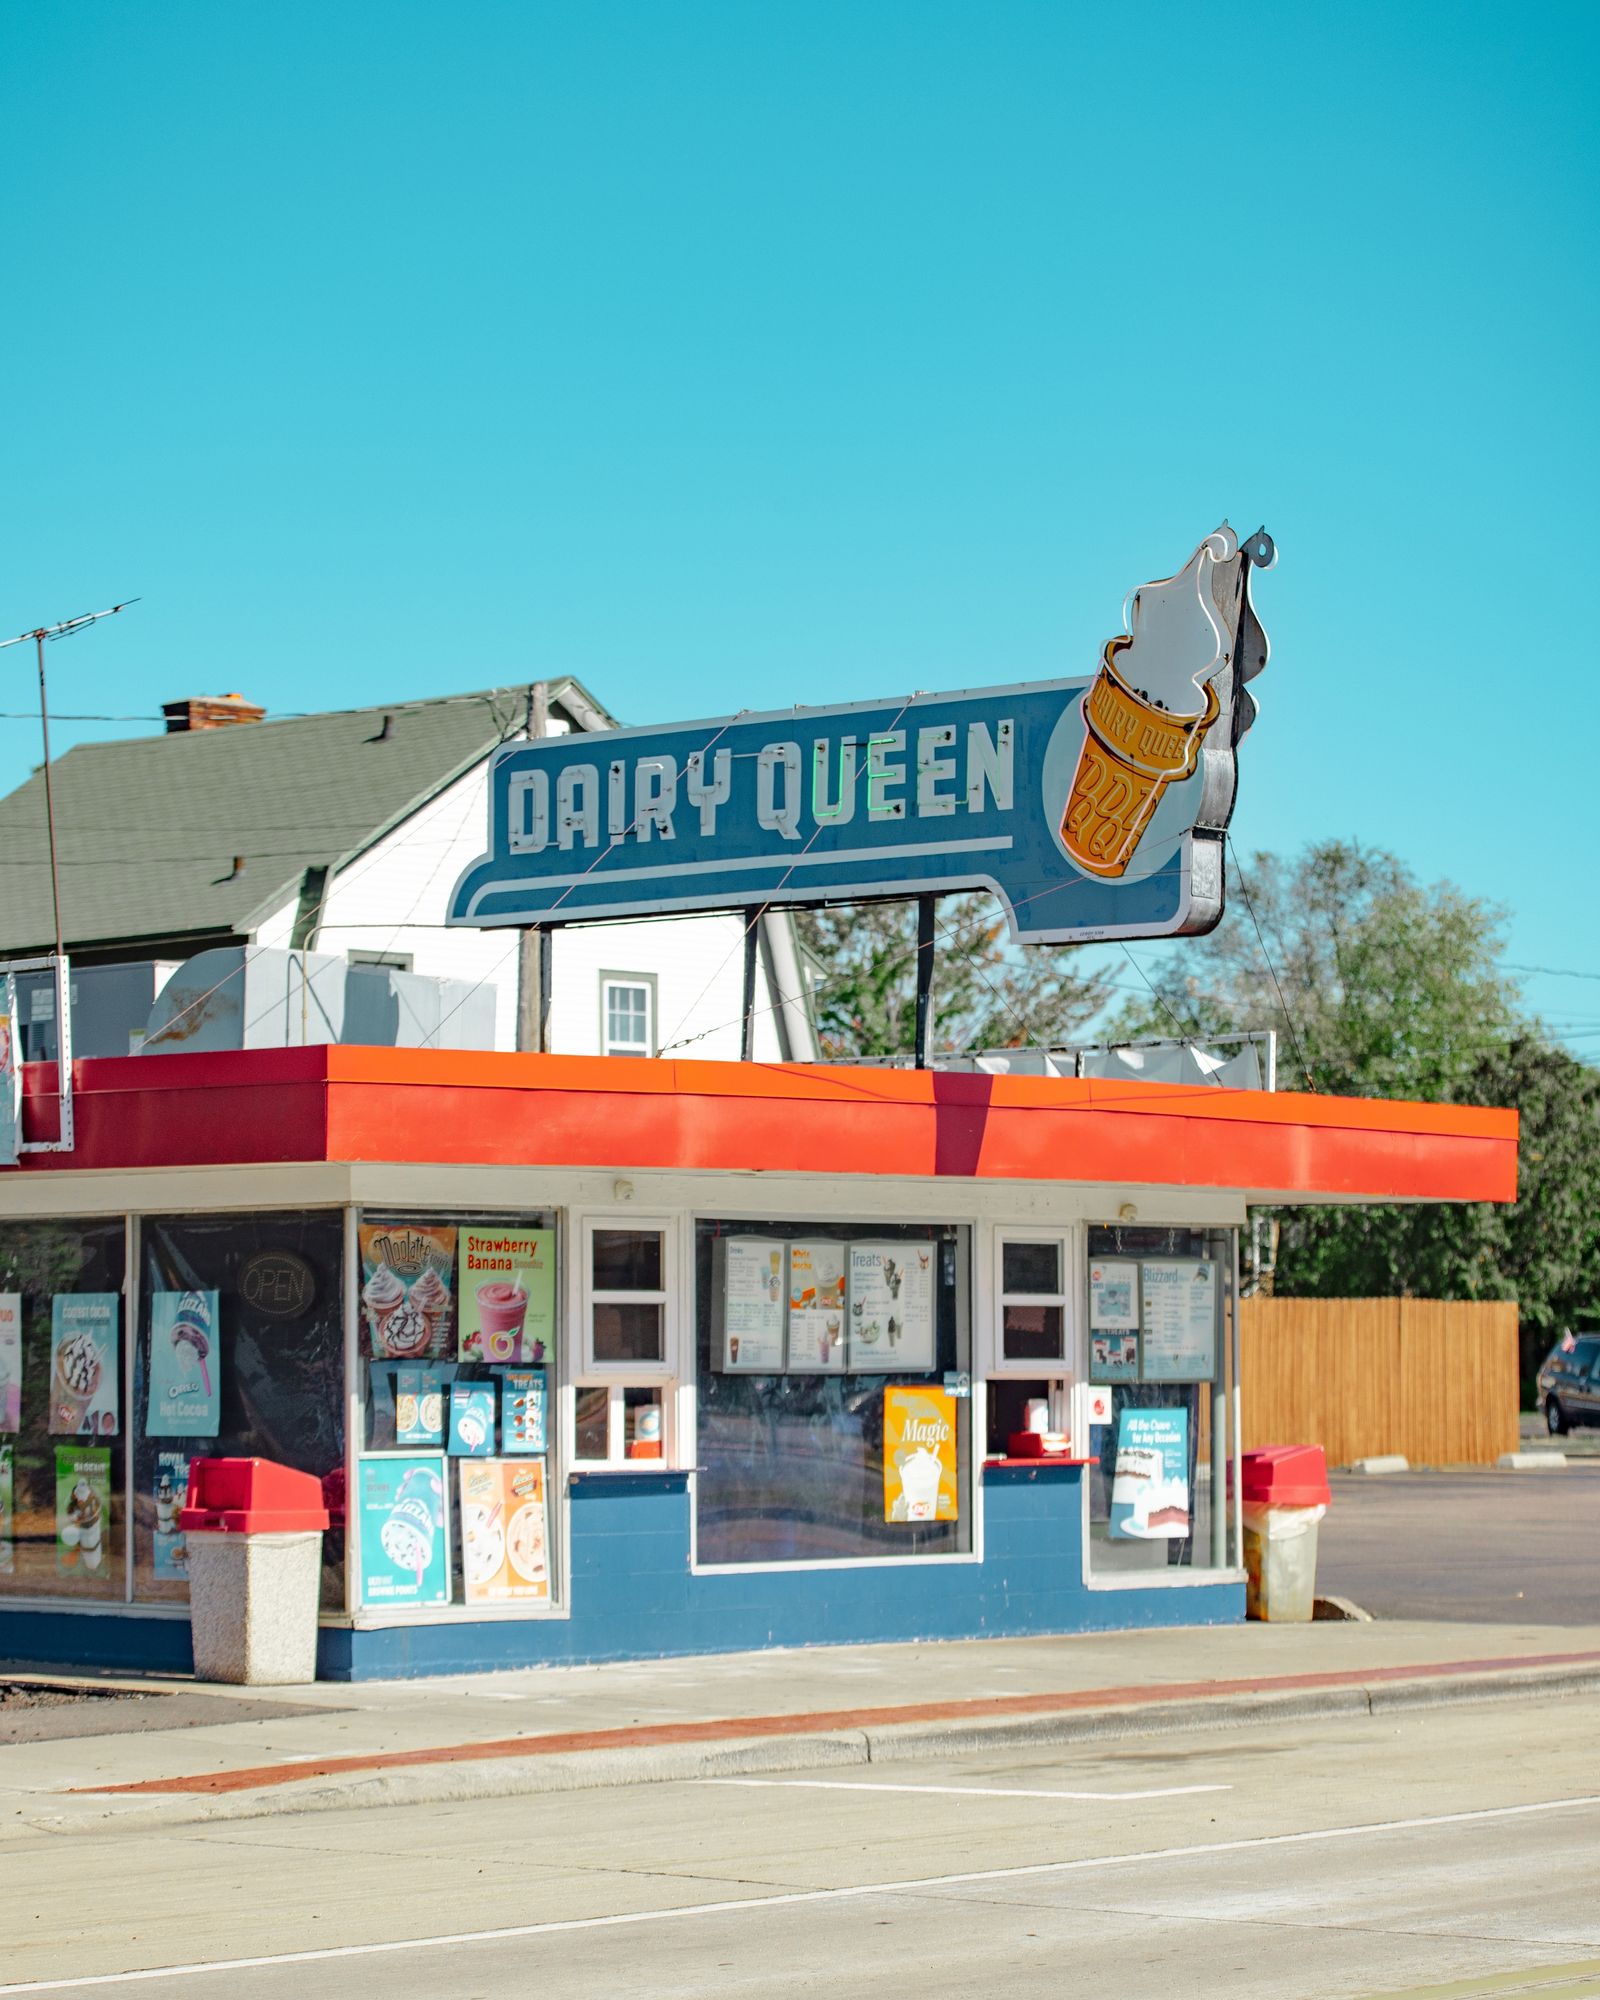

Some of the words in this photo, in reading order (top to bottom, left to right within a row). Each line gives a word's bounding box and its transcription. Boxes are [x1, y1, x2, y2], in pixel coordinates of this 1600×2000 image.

[1094, 685, 1139, 742] DAIRY
[1138, 725, 1199, 760] QUEEN
[507, 746, 732, 856] DAIRY
[757, 718, 1015, 840] QUEEN
[467, 1236, 539, 1258] Strawberry
[467, 1255, 512, 1271] Banana
[852, 1251, 882, 1268] Treats
[1143, 1266, 1179, 1283] Blizzard
[242, 1268, 307, 1302] OPEN
[168, 1383, 200, 1399] OREO
[512, 1378, 544, 1390] TREATS
[159, 1400, 176, 1417] Hot
[177, 1401, 209, 1417] Cocoa
[902, 1418, 950, 1448] Magic
[158, 1452, 185, 1467] ROYAL
